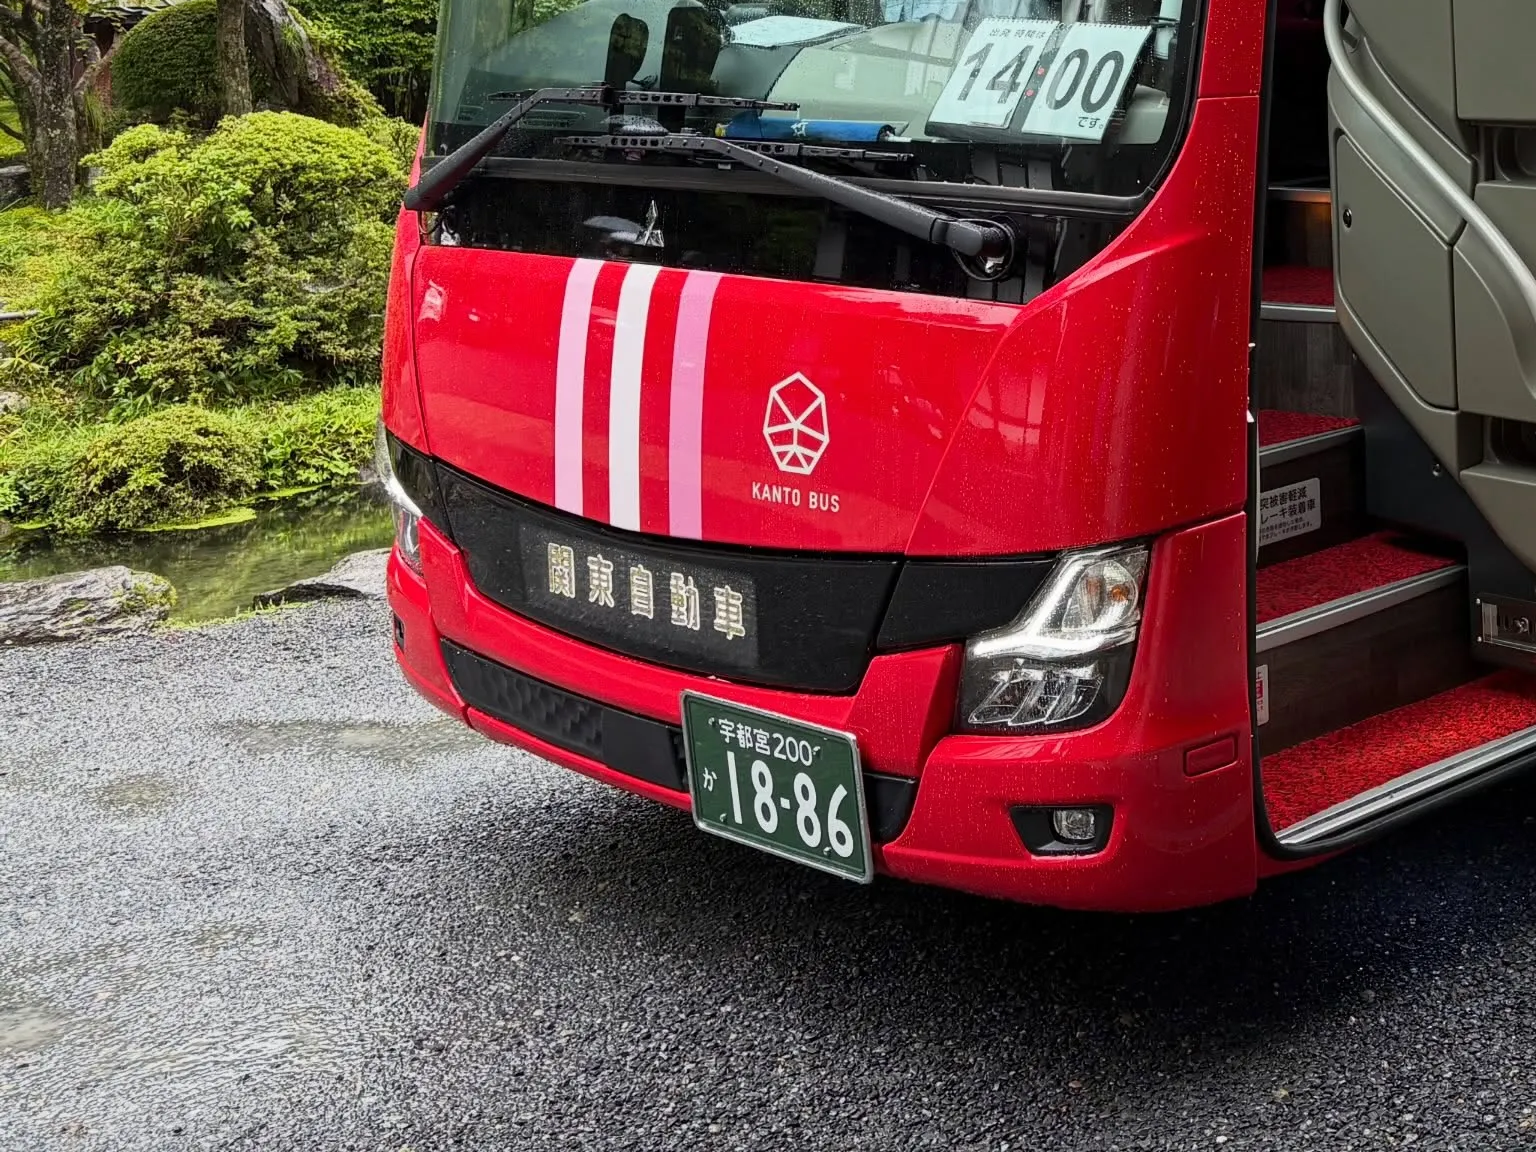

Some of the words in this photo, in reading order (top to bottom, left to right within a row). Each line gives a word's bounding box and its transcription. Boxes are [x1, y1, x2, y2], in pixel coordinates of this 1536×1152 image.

[751, 481, 801, 507] KANTO
[808, 491, 840, 513] BUS
[547, 542, 746, 641] 関東自動車
[702, 766, 718, 792] か
[726, 750, 854, 858] 18-86
